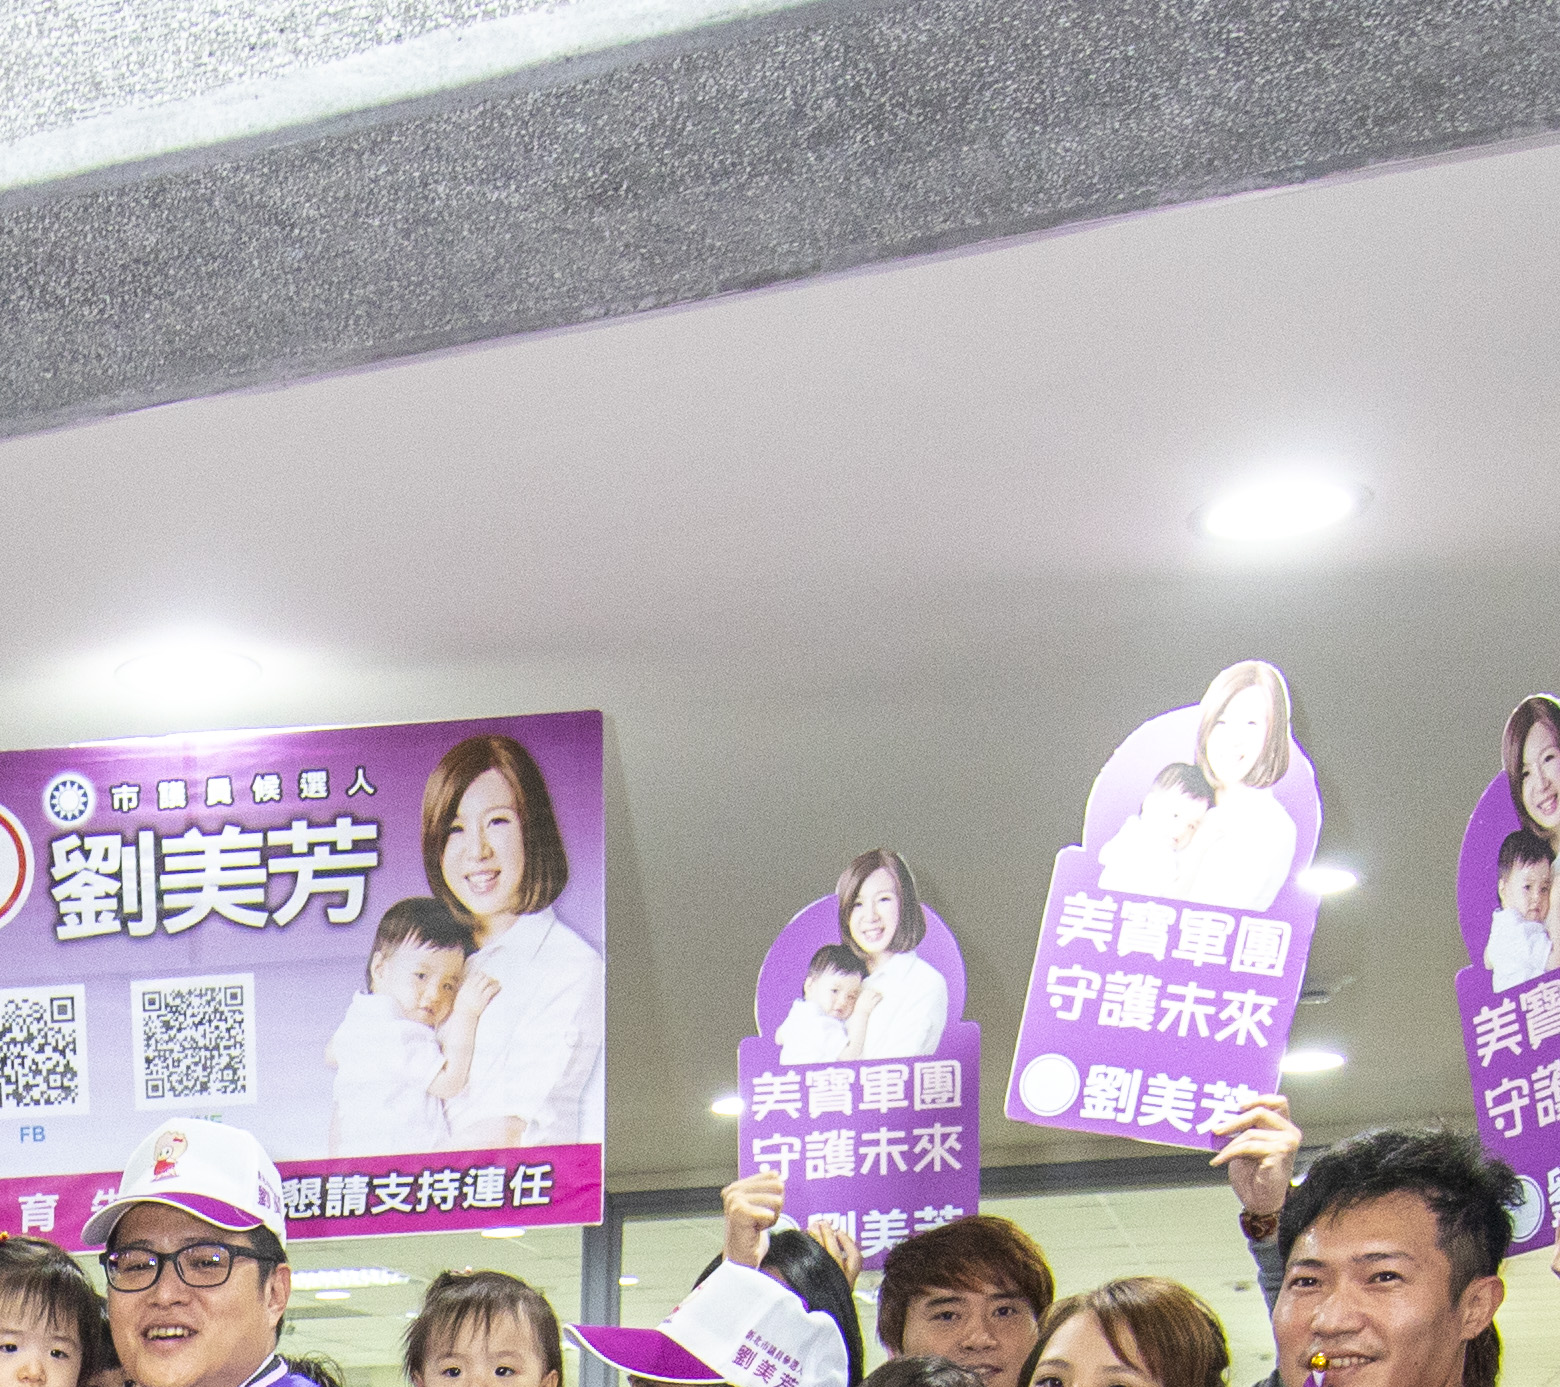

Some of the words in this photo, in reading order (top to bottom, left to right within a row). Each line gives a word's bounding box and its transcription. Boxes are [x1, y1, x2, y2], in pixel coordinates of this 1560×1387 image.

[110, 768, 377, 812] 市議員候選人
[51, 817, 379, 940] 劉美芳
[1055, 892, 1293, 977] 美寶軍團
[1046, 966, 1279, 1049] 守護未來
[752, 1059, 963, 1122] 美寶軍團
[19, 1125, 46, 1143] FB
[752, 1124, 963, 1181] 守護未來
[282, 1163, 553, 1221] 懇請支持連任
